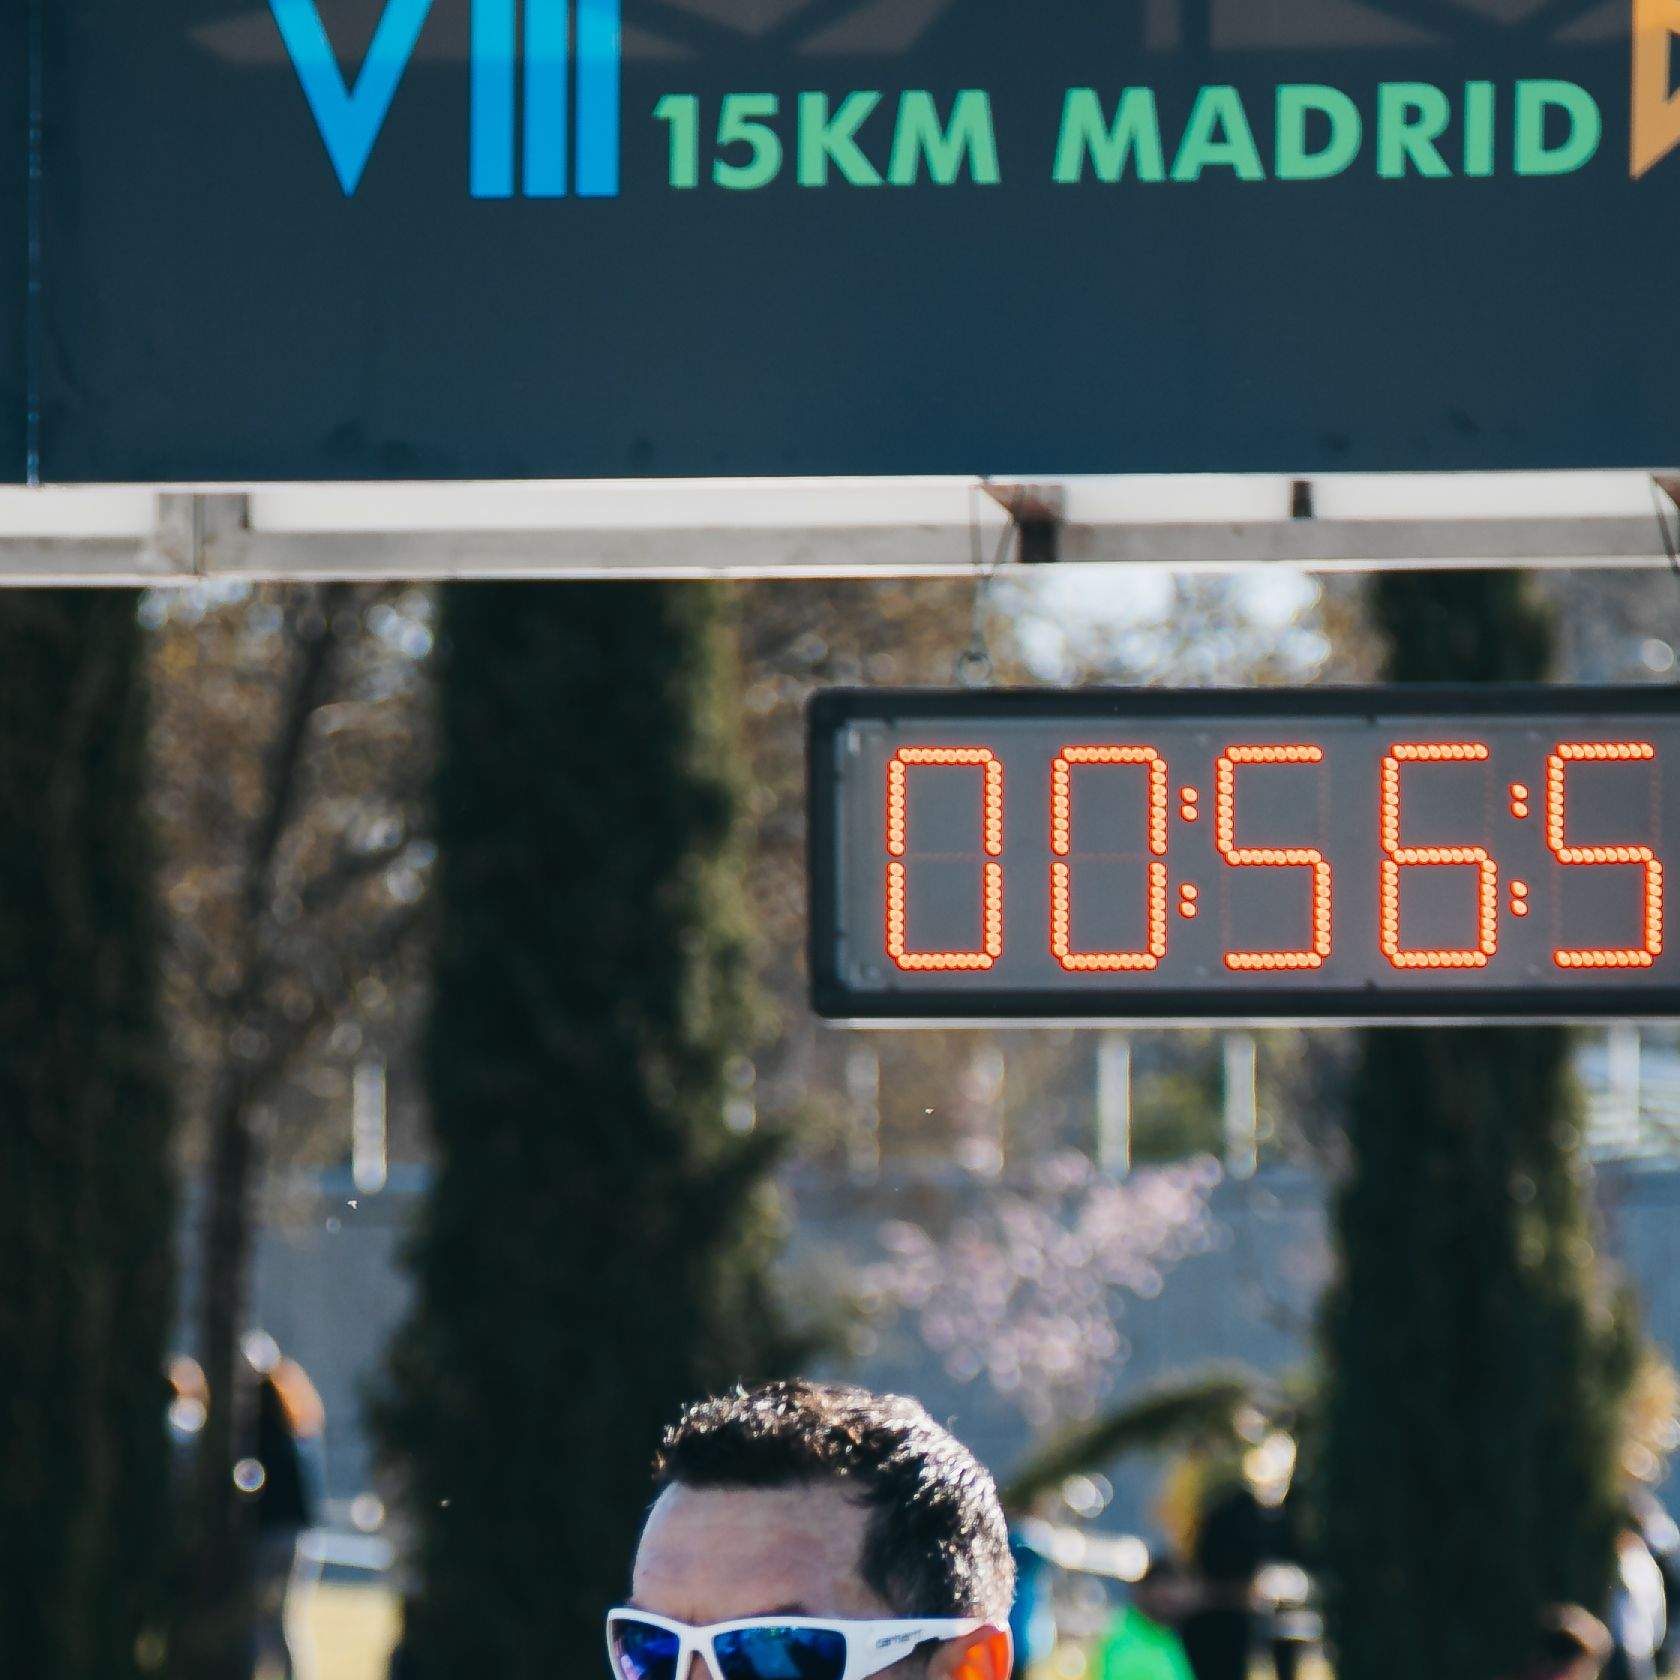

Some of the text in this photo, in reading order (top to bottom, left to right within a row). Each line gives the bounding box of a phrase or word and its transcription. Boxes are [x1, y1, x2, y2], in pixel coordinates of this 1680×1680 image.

[267, 0, 622, 198] VIII
[652, 90, 1002, 190] 15KM
[1051, 79, 1604, 186] MADRID
